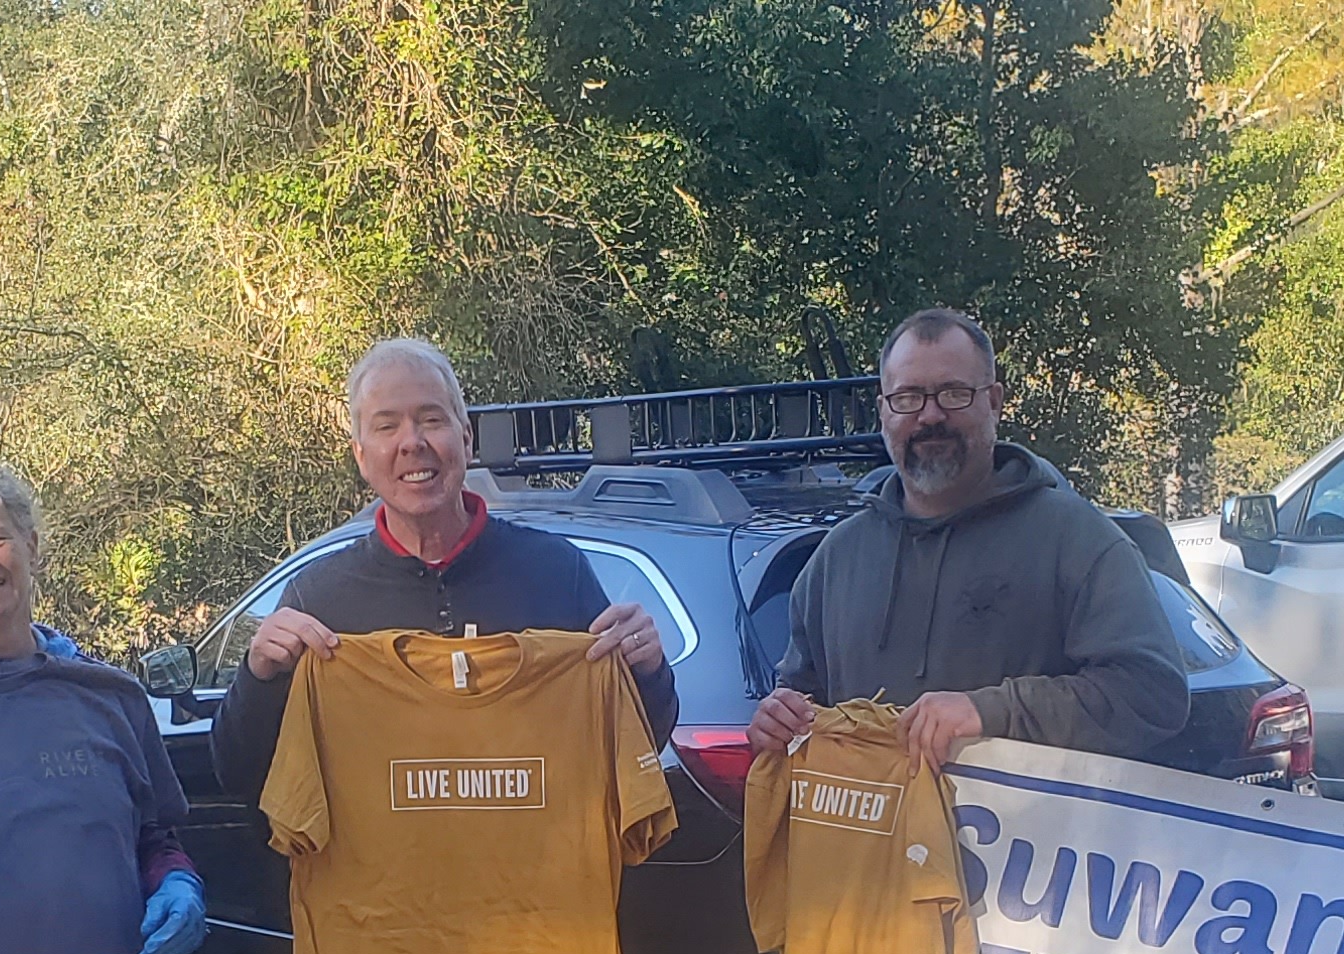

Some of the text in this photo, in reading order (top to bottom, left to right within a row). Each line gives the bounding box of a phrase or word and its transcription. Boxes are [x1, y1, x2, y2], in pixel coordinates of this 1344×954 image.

[406, 769, 529, 799] LIVE UNITED
[811, 783, 886, 822] UNITED
